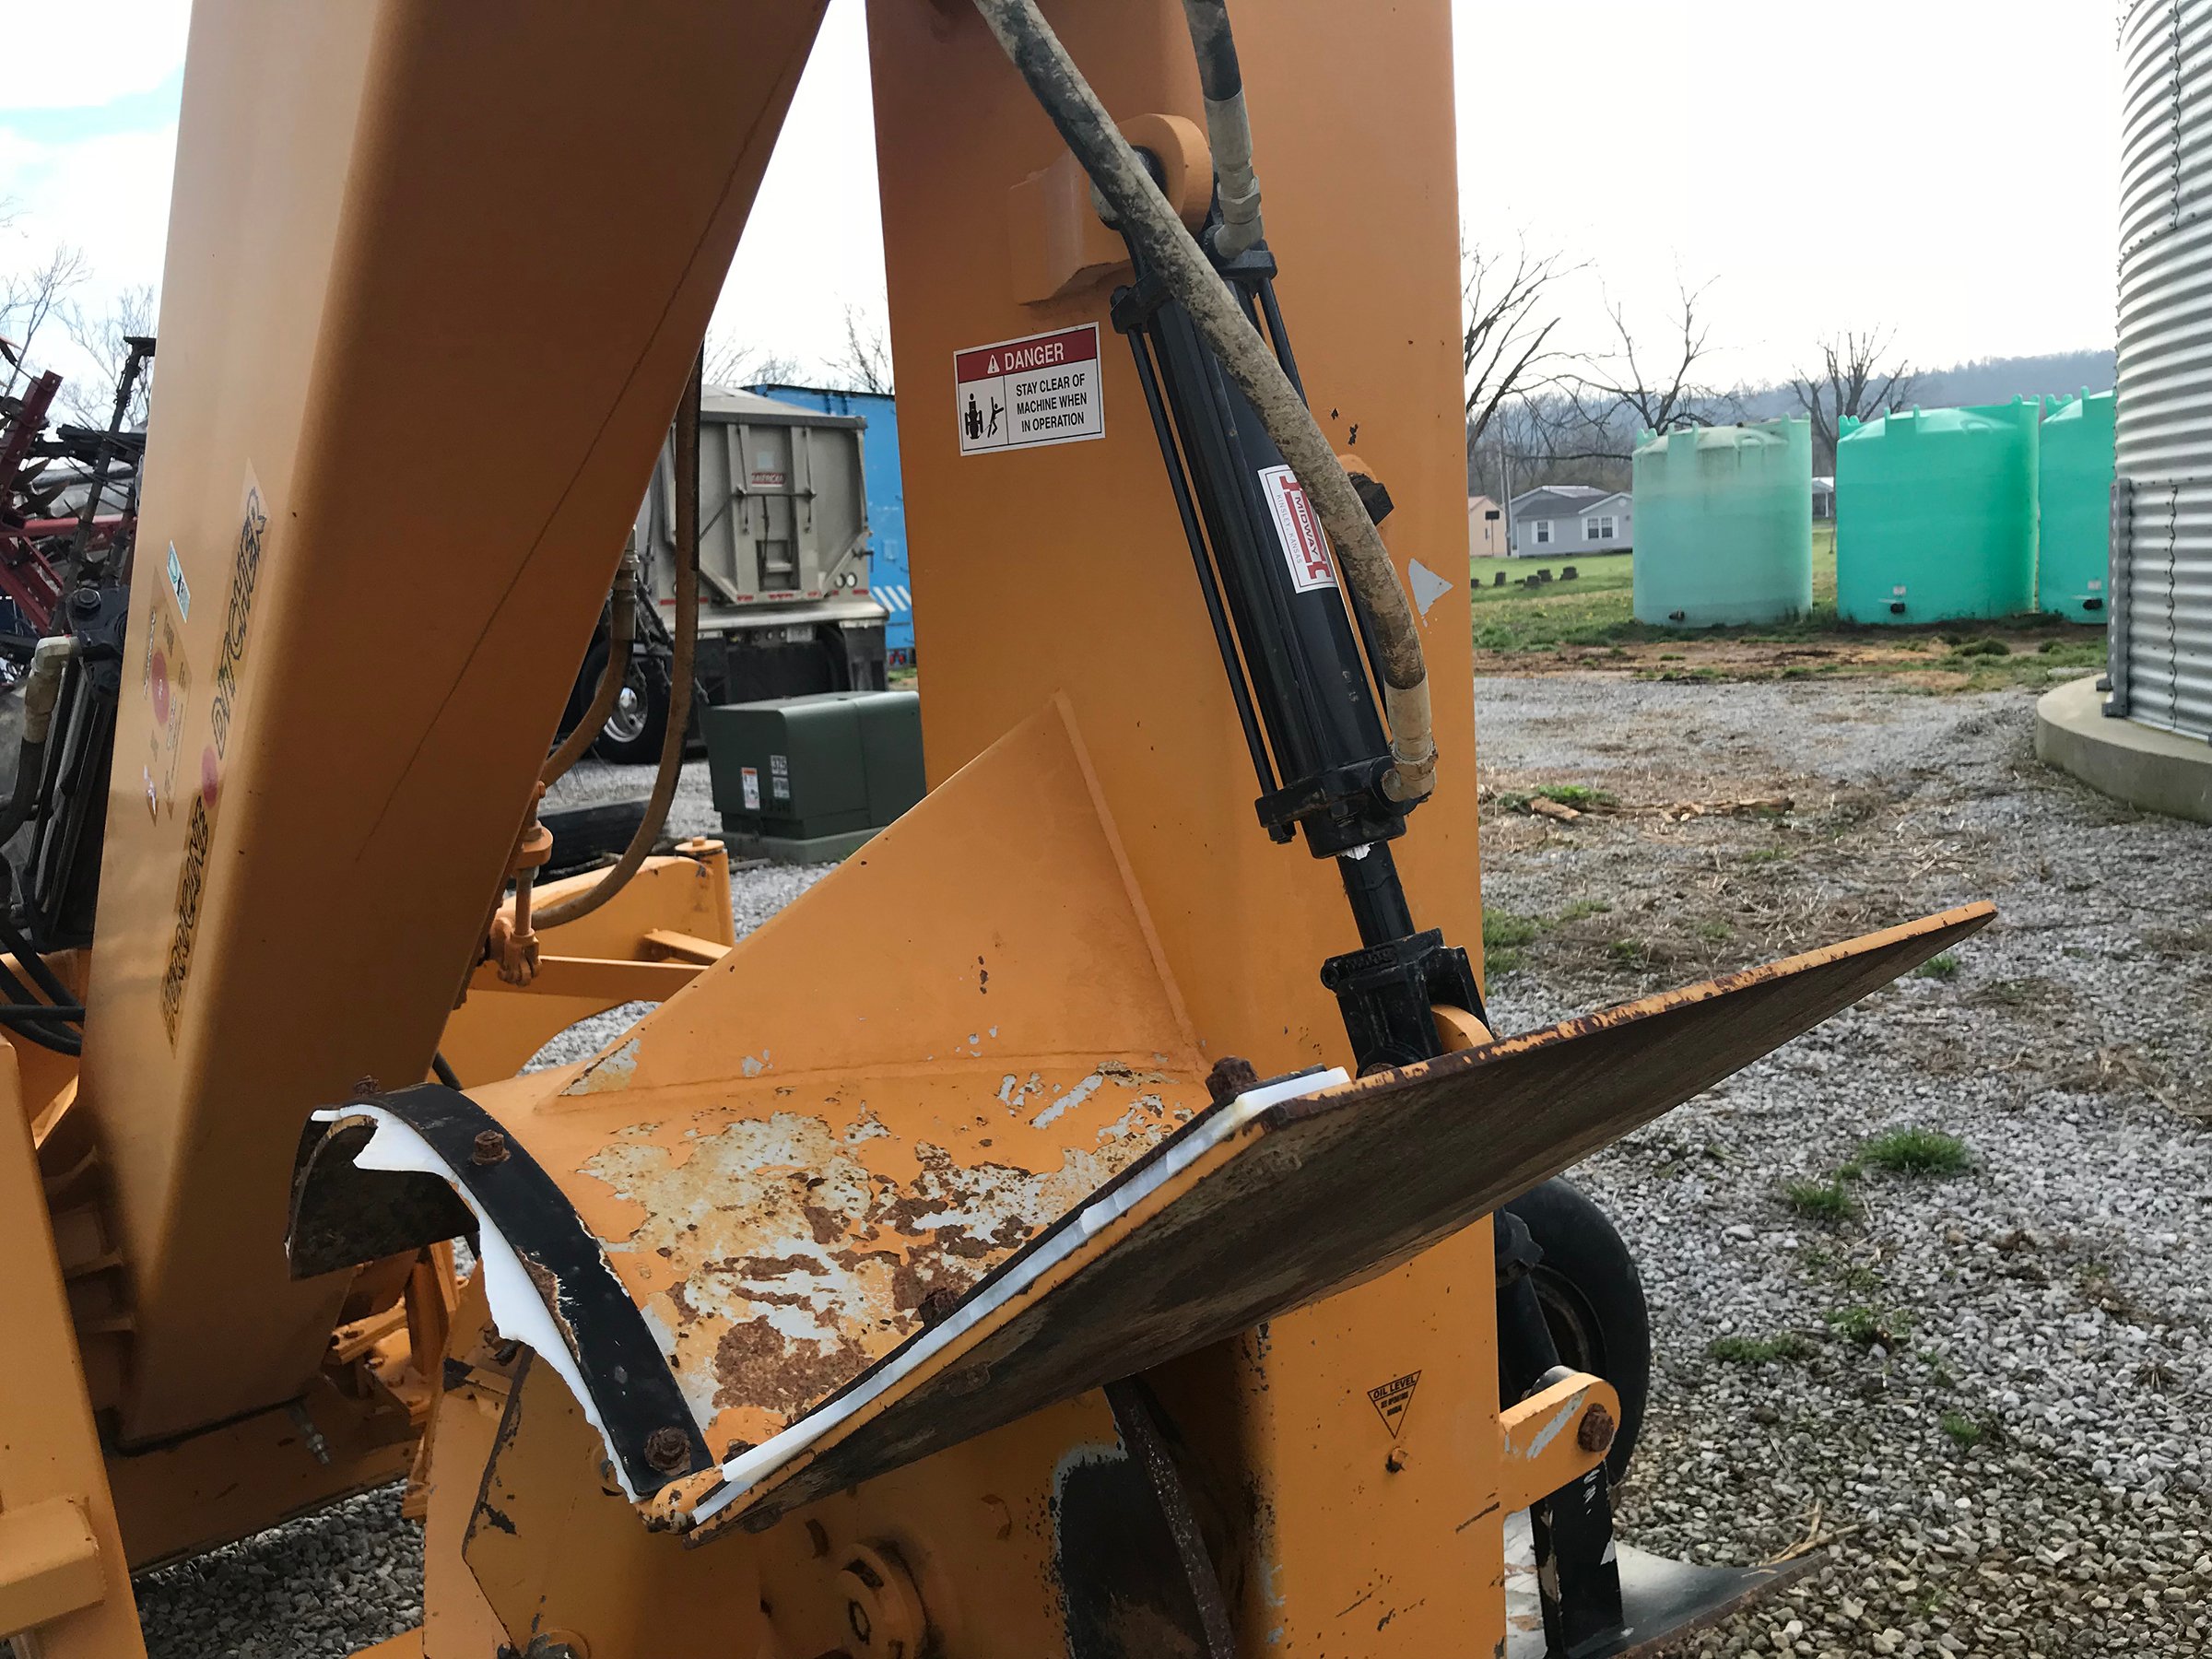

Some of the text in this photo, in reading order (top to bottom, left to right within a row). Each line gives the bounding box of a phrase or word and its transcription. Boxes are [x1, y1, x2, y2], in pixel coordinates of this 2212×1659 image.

[1004, 342, 1065, 371] DANGER
[1016, 373, 1086, 397] STAY CLEAR OF
[1017, 392, 1088, 415] MACHINE WHEN
[1021, 412, 1085, 432] IN OPERATION
[1295, 496, 1319, 556] MIDWAY
[1289, 533, 1303, 564] KANSAS
[211, 487, 267, 760] DITCHER
[1372, 1375, 1416, 1399] OIL LEVEL
